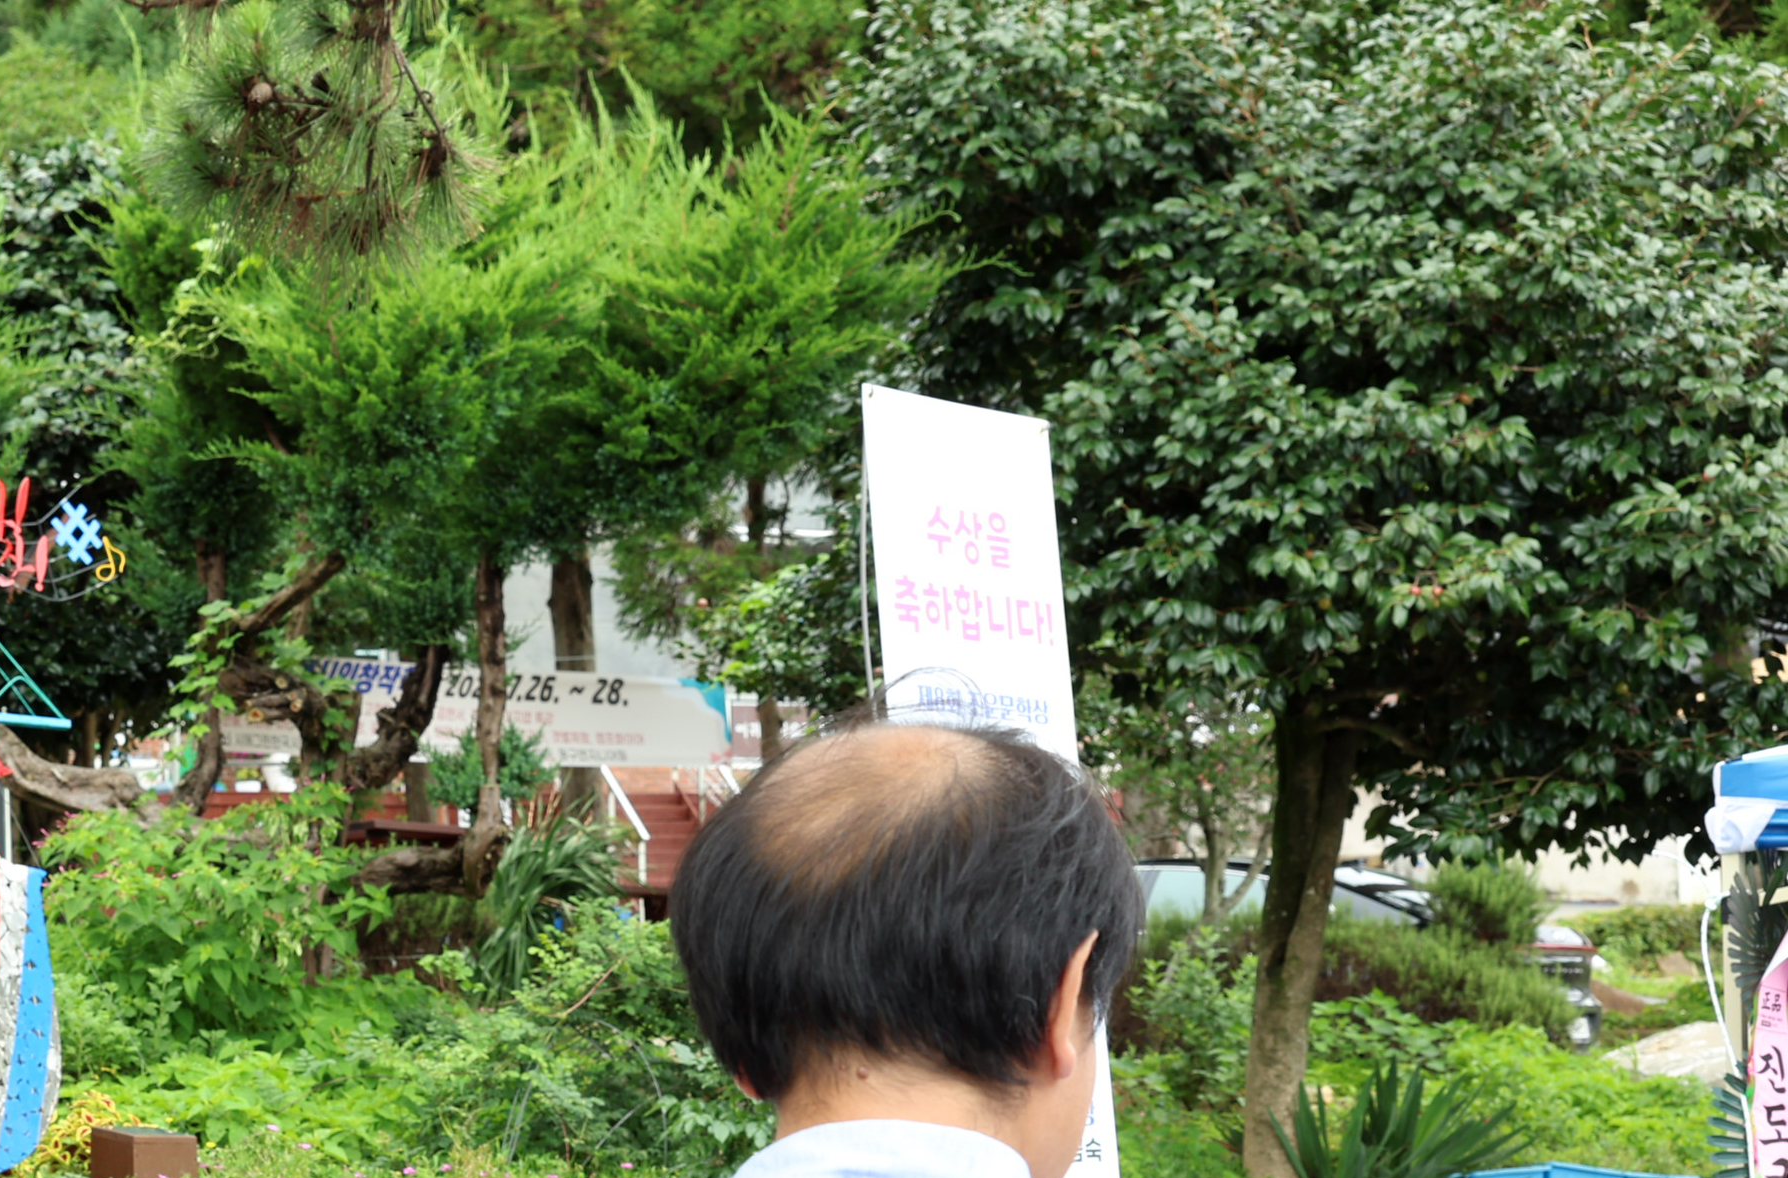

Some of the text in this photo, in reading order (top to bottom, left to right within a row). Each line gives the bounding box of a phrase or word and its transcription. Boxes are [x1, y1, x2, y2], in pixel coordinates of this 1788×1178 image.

[927, 506, 1011, 569] 수상을
[894, 575, 1055, 646] 축하합니다!
[592, 678, 629, 706] 28.
